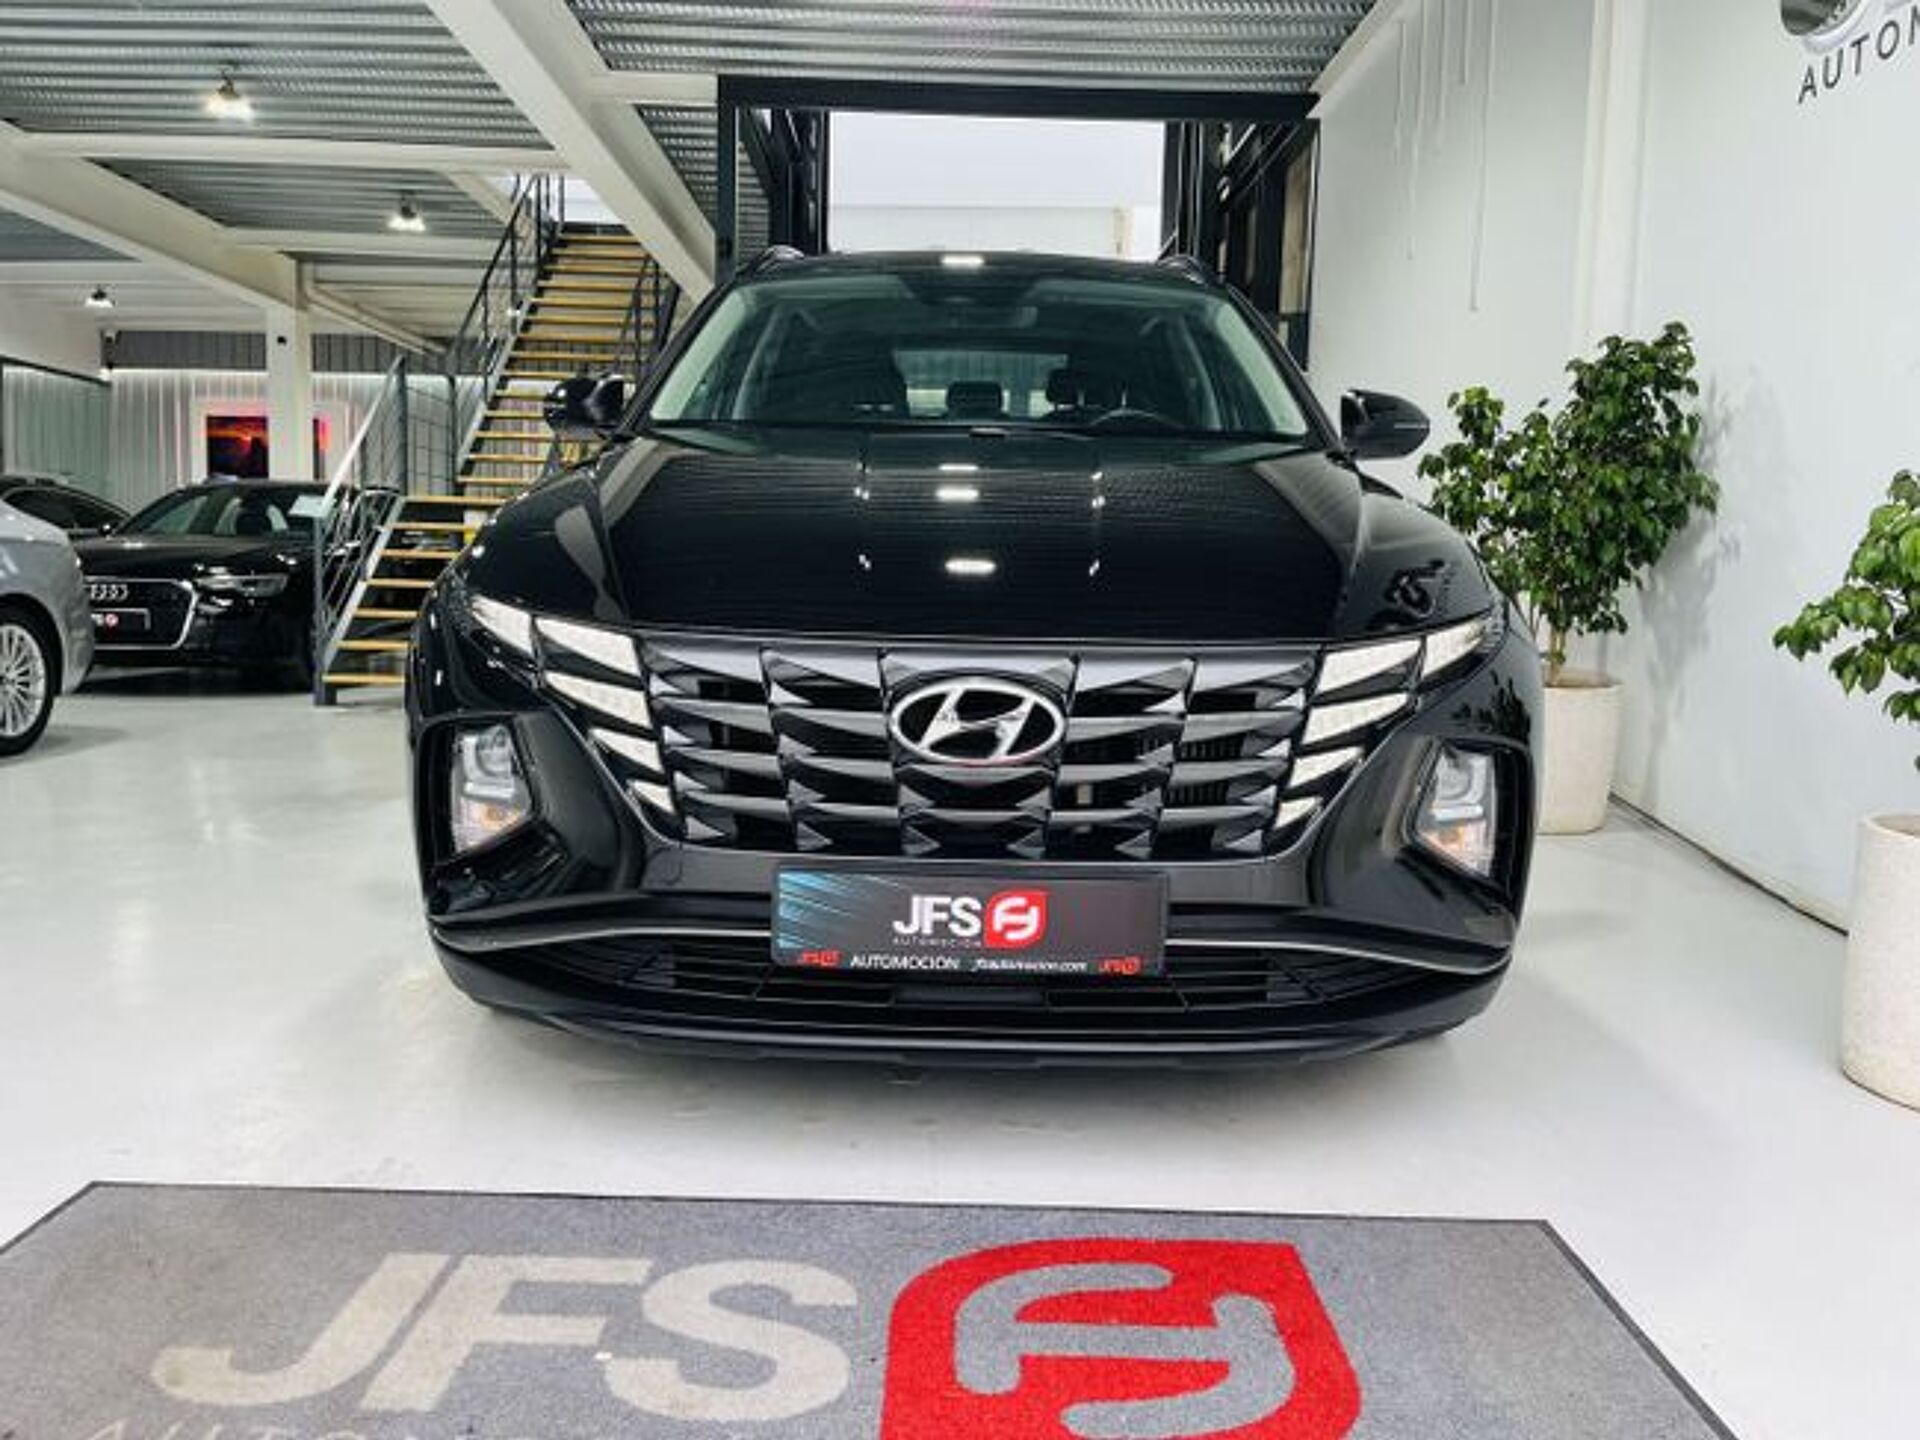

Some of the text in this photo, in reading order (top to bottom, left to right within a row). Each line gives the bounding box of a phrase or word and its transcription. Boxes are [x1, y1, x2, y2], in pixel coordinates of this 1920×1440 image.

[892, 894, 982, 937] JFS
[850, 954, 960, 969] AUTOMOCION
[150, 1252, 858, 1421] JFS
